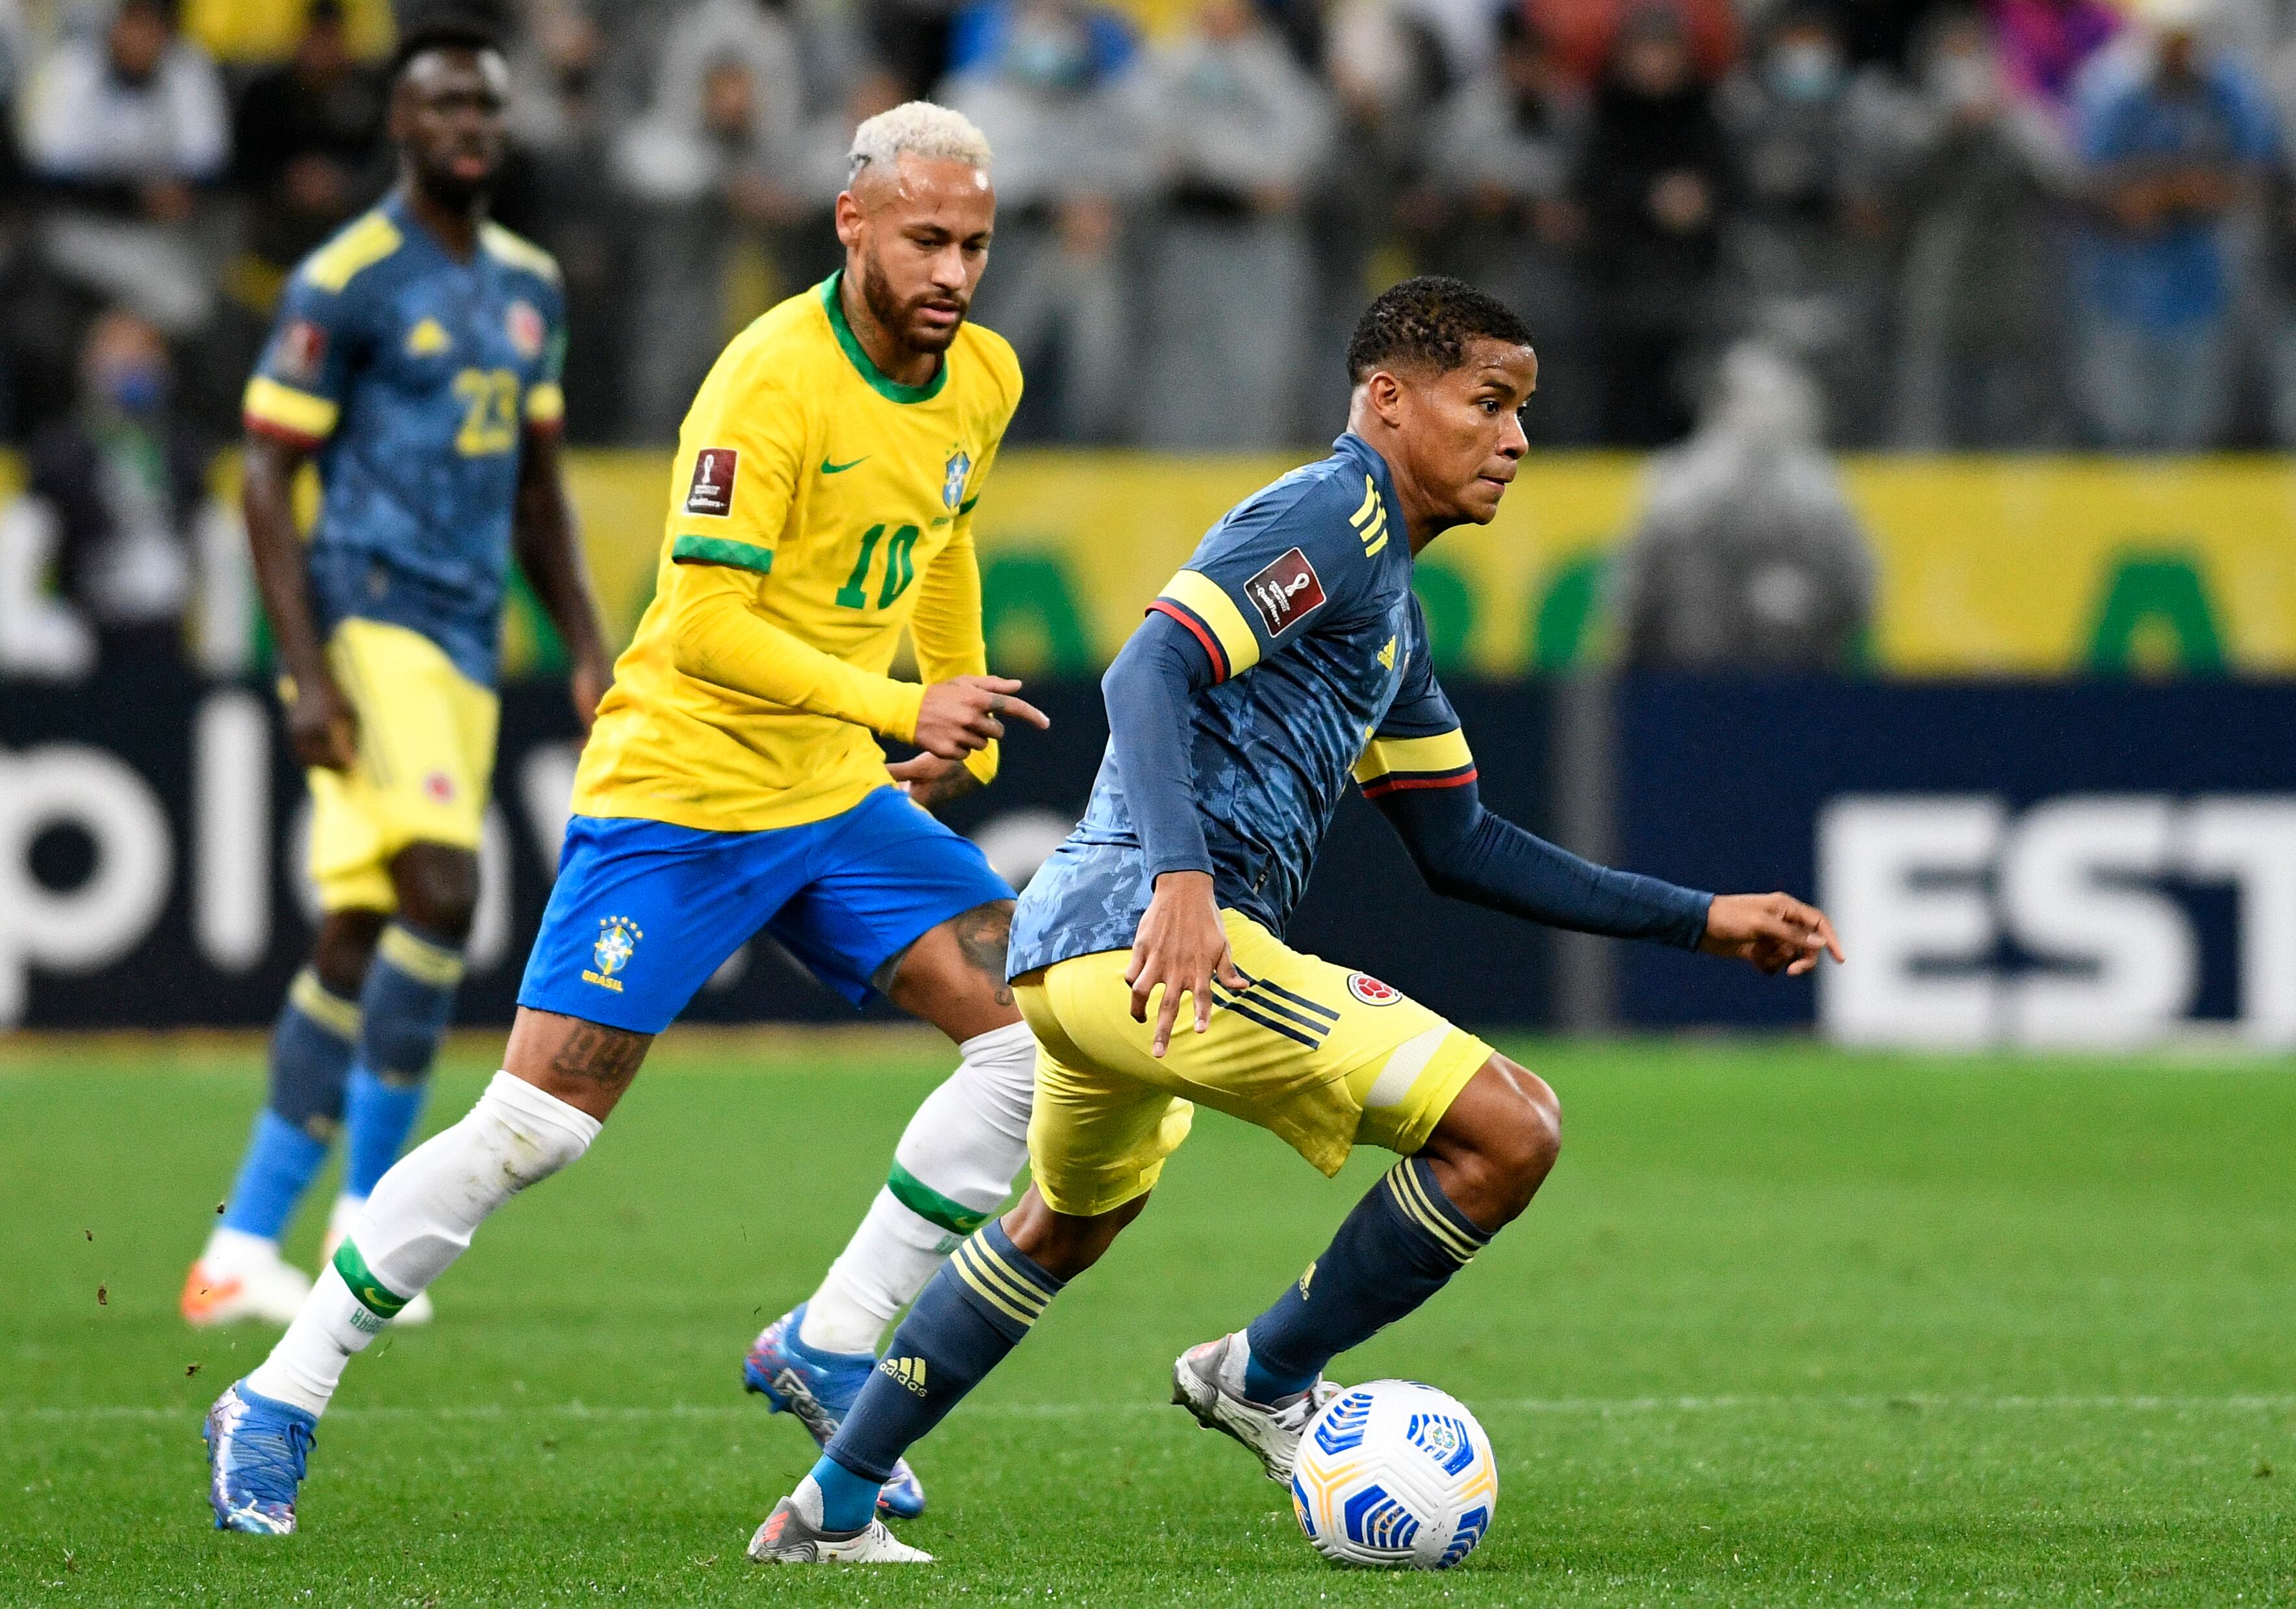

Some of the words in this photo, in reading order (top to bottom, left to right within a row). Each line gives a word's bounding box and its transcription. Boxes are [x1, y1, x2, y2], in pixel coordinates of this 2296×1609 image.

[453, 368, 519, 456] 23
[835, 523, 919, 610] 10
[1258, 587, 1280, 622] Qualifiers
[582, 969, 623, 992] BRASIL
[879, 1362, 927, 1397] adidas
